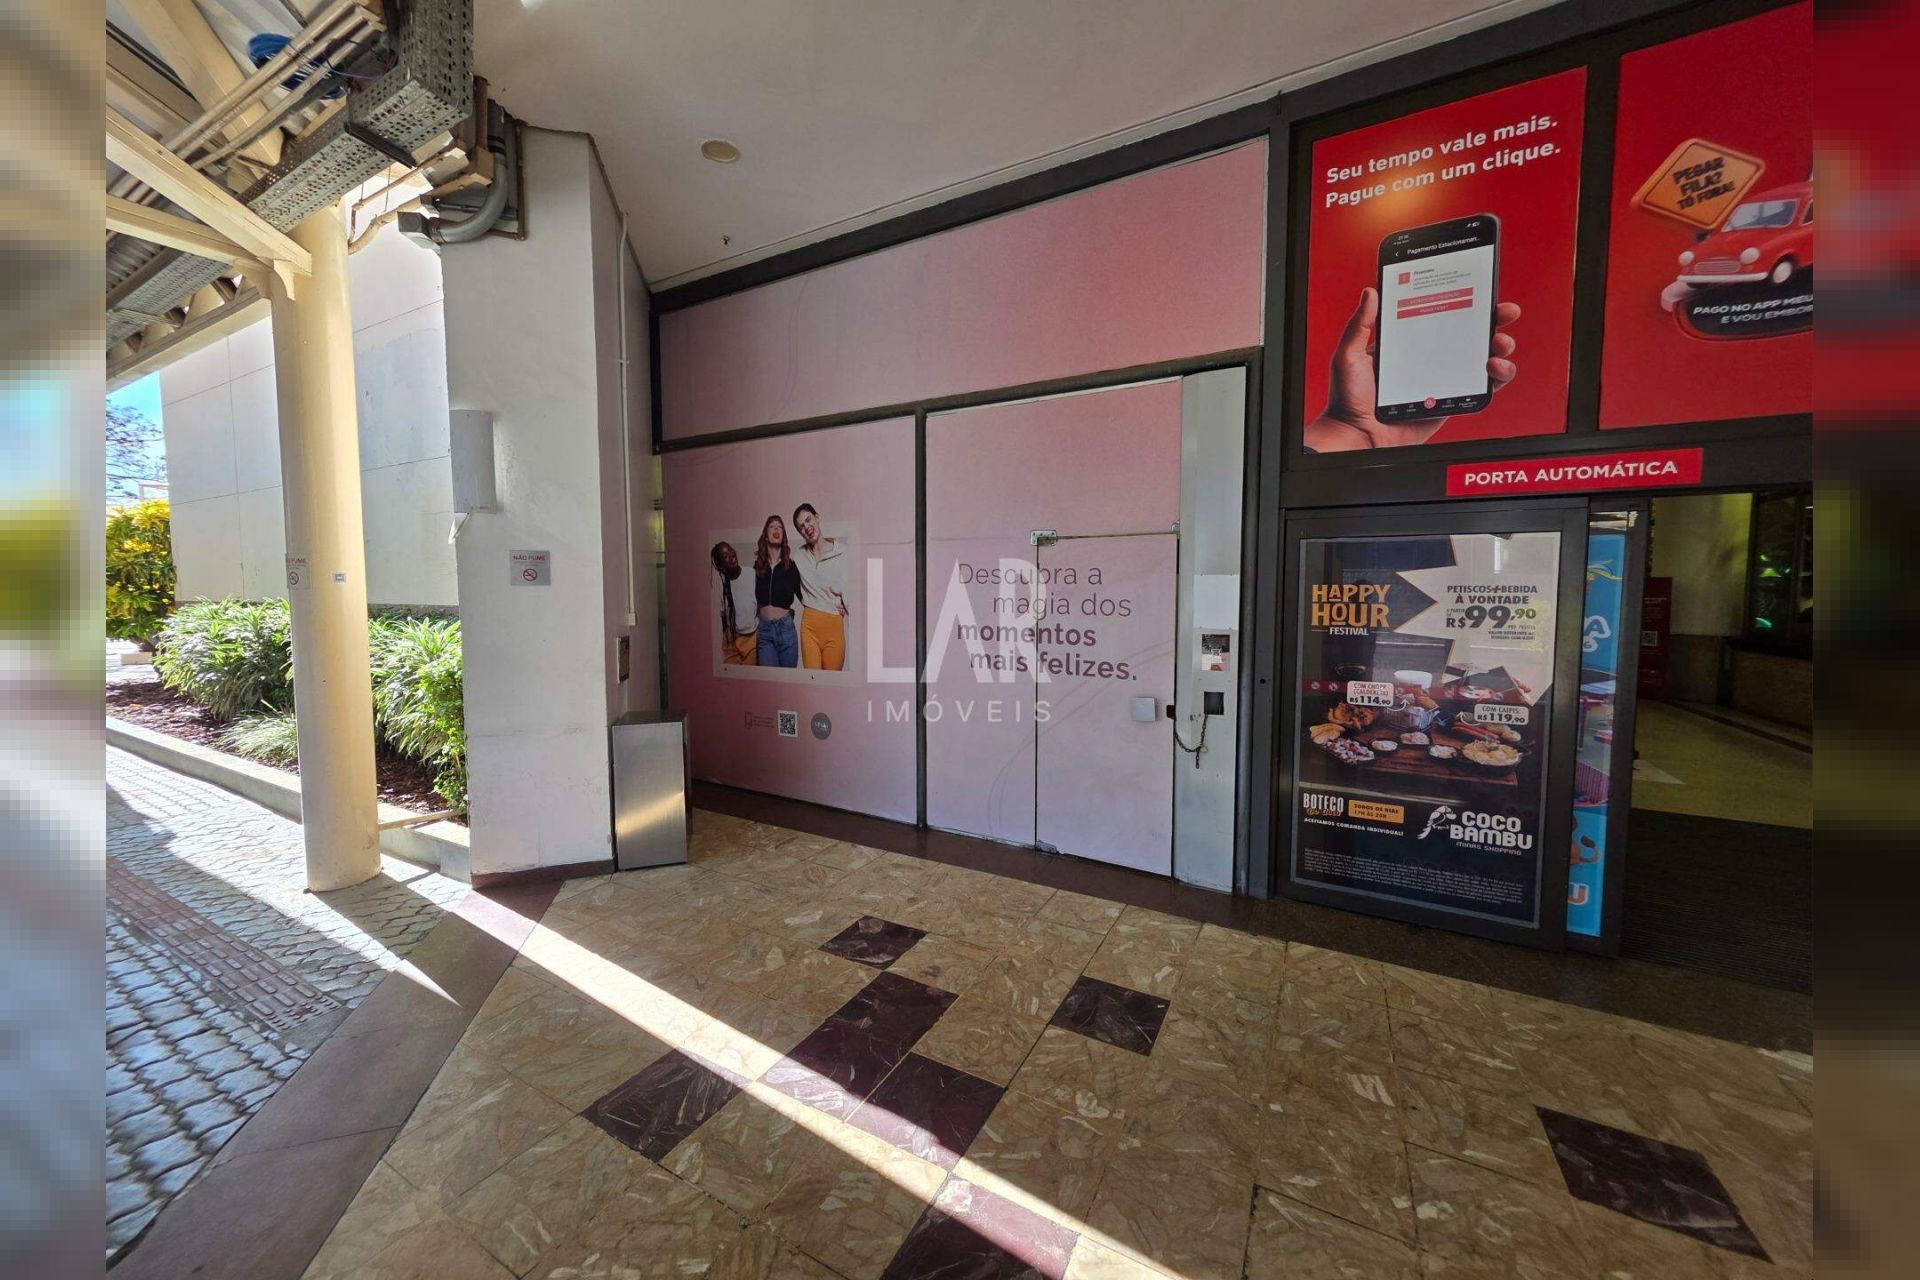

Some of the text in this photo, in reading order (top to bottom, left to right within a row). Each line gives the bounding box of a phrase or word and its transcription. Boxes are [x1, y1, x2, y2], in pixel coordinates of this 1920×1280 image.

[1326, 114, 1558, 184] Seu tempo vale mais.
[1325, 142, 1561, 208] Pague com um clique.
[1673, 156, 1725, 185] PEGAR
[1681, 171, 1723, 196] FILA?
[1693, 305, 1729, 315] PAGO
[1731, 303, 1751, 312] NO
[1752, 299, 1781, 310] APP
[1721, 315, 1730, 324] E
[1732, 312, 1762, 322] VOU
[1464, 460, 1678, 486] PORTA AUTOMÁTICA
[957, 562, 1103, 585] Descubra a
[1312, 584, 1391, 603] HAPPY
[1455, 593, 1529, 604] À VONTADE
[993, 592, 1131, 620] magia dos
[1311, 602, 1390, 628] HOUR
[957, 623, 1096, 646] momentos
[1329, 627, 1369, 636] FESTIVAL
[970, 650, 1137, 681] mais felizes.
[1482, 705, 1497, 713] COM
[1303, 792, 1344, 814] BOTECO
[1354, 803, 1374, 811] TODOS
[1304, 817, 1335, 827] ACEITAMOS
[1336, 821, 1366, 831] COMANDA
[1461, 811, 1522, 833] COCO
[1449, 824, 1533, 850] BAMBU
